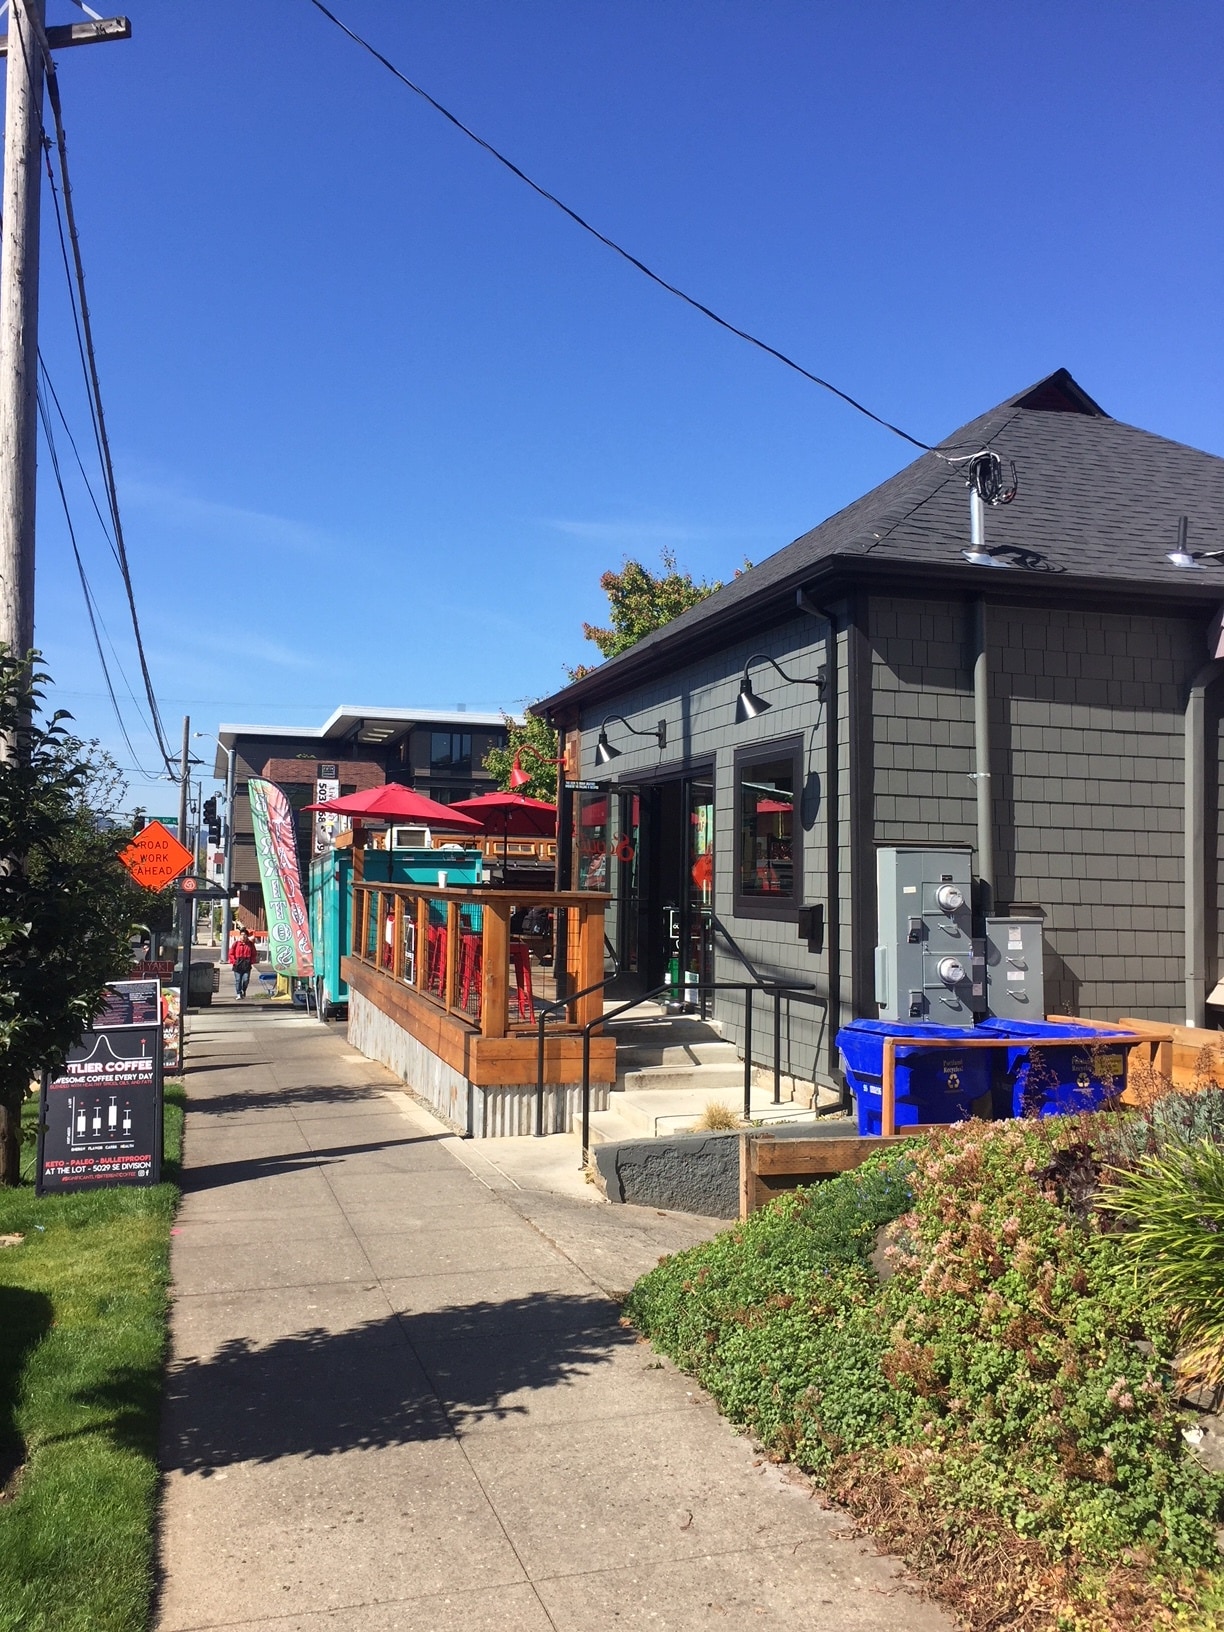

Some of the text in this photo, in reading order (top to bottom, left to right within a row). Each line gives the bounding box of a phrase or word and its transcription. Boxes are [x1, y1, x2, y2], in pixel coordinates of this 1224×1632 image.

[140, 840, 169, 850] ROAD
[140, 853, 169, 863] WORK
[137, 866, 173, 876] AHEAD
[67, 1060, 153, 1074] TLIER COFFEE
[51, 1072, 154, 1085] WESOME COFFEE EVERY DAY
[45, 1155, 152, 1168] KETO PALEO BULLETPROOF!
[57, 1166, 70, 1174] THE
[72, 1165, 87, 1173] LOT
[93, 1164, 111, 1172] 5029
[112, 1163, 120, 1171] SE
[121, 1161, 152, 1170] DIVISION
